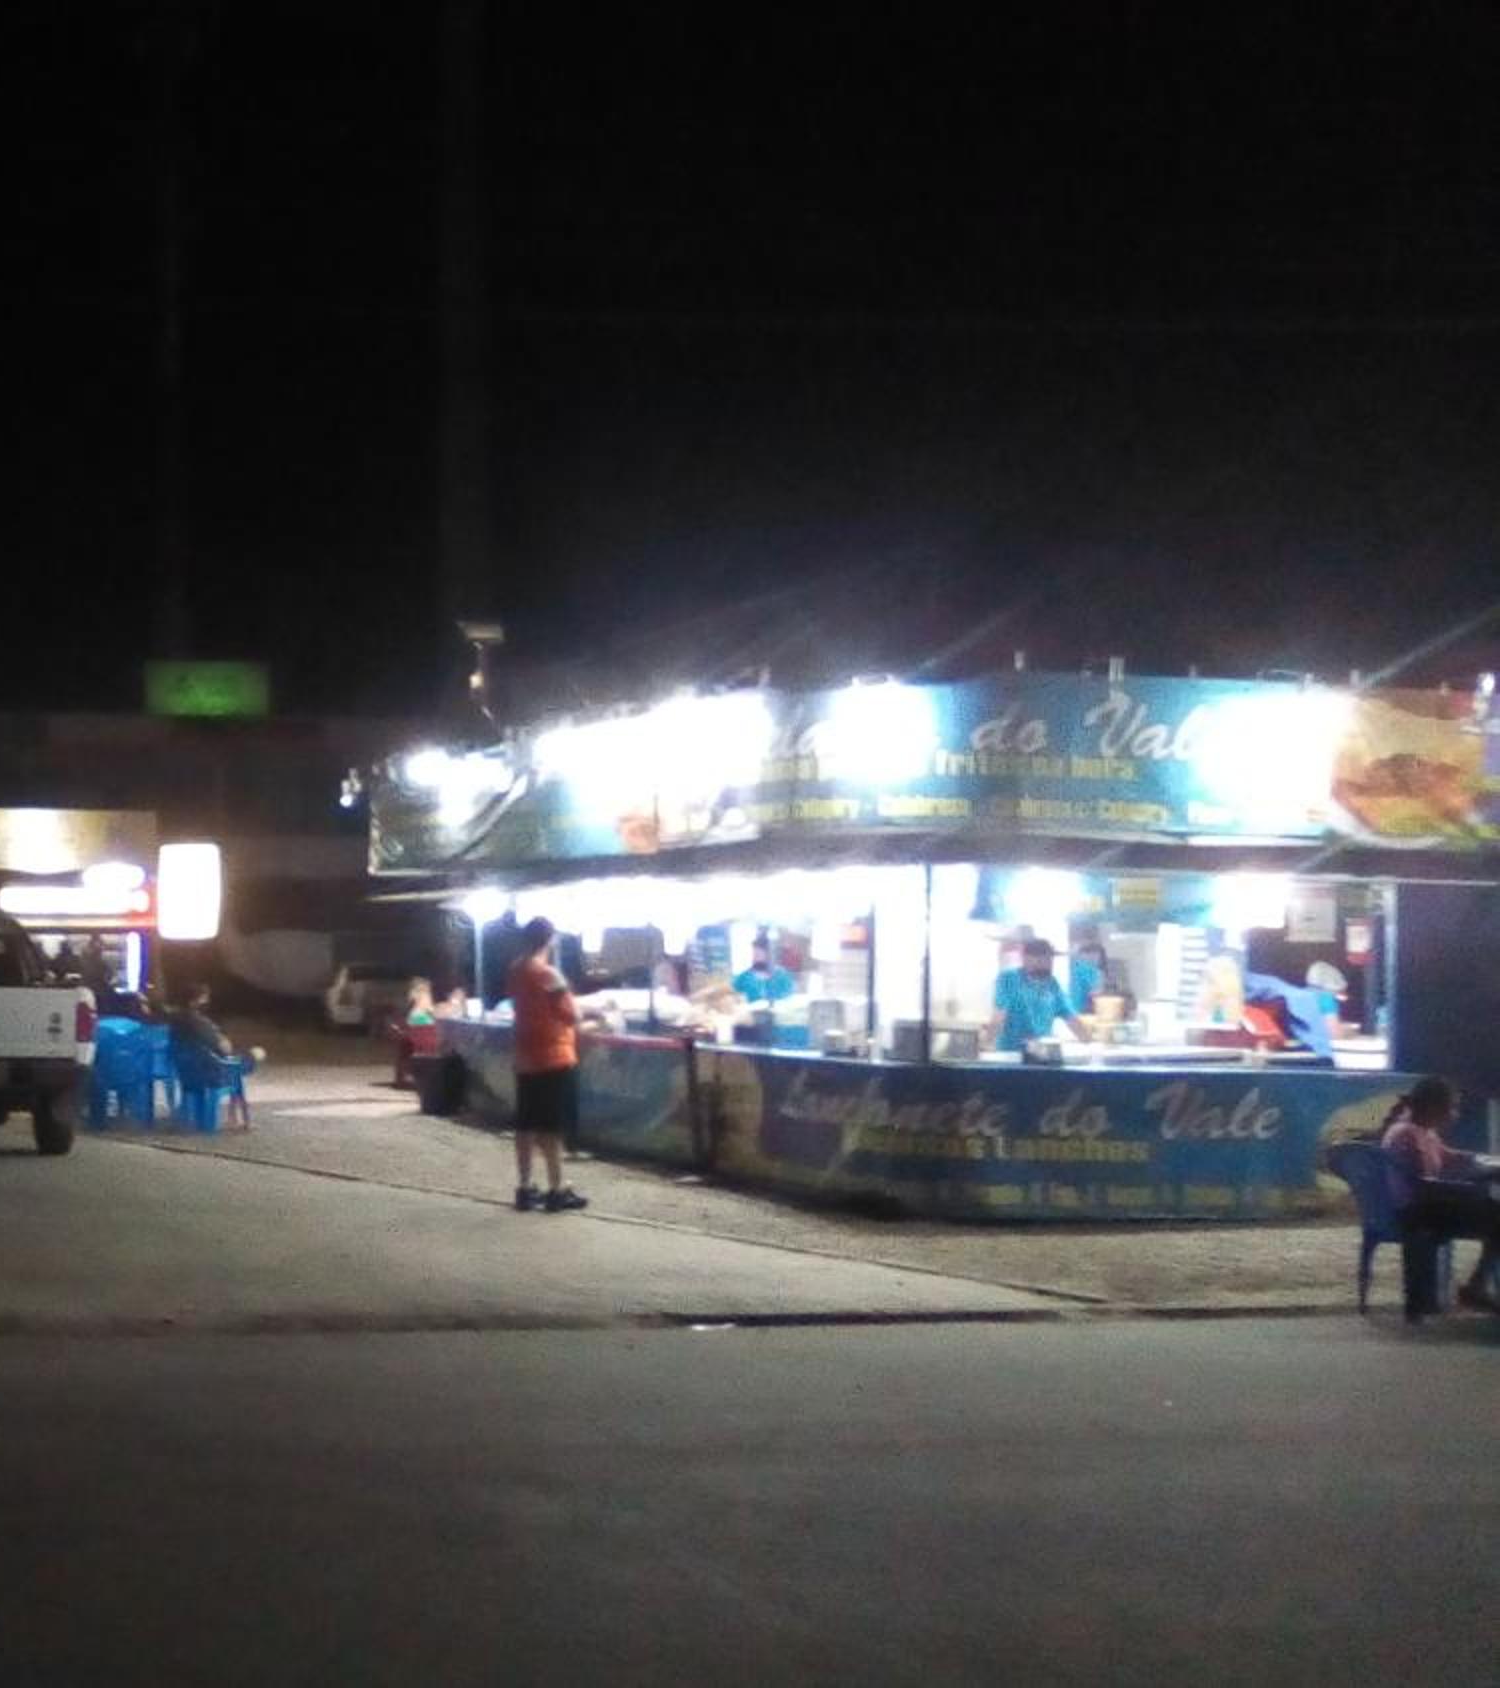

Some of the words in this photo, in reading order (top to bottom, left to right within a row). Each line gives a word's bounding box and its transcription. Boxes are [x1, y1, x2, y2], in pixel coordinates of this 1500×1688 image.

[1085, 690, 1216, 758] Val
[1040, 1086, 1110, 1137] do
[1143, 1080, 1282, 1140] Vale
